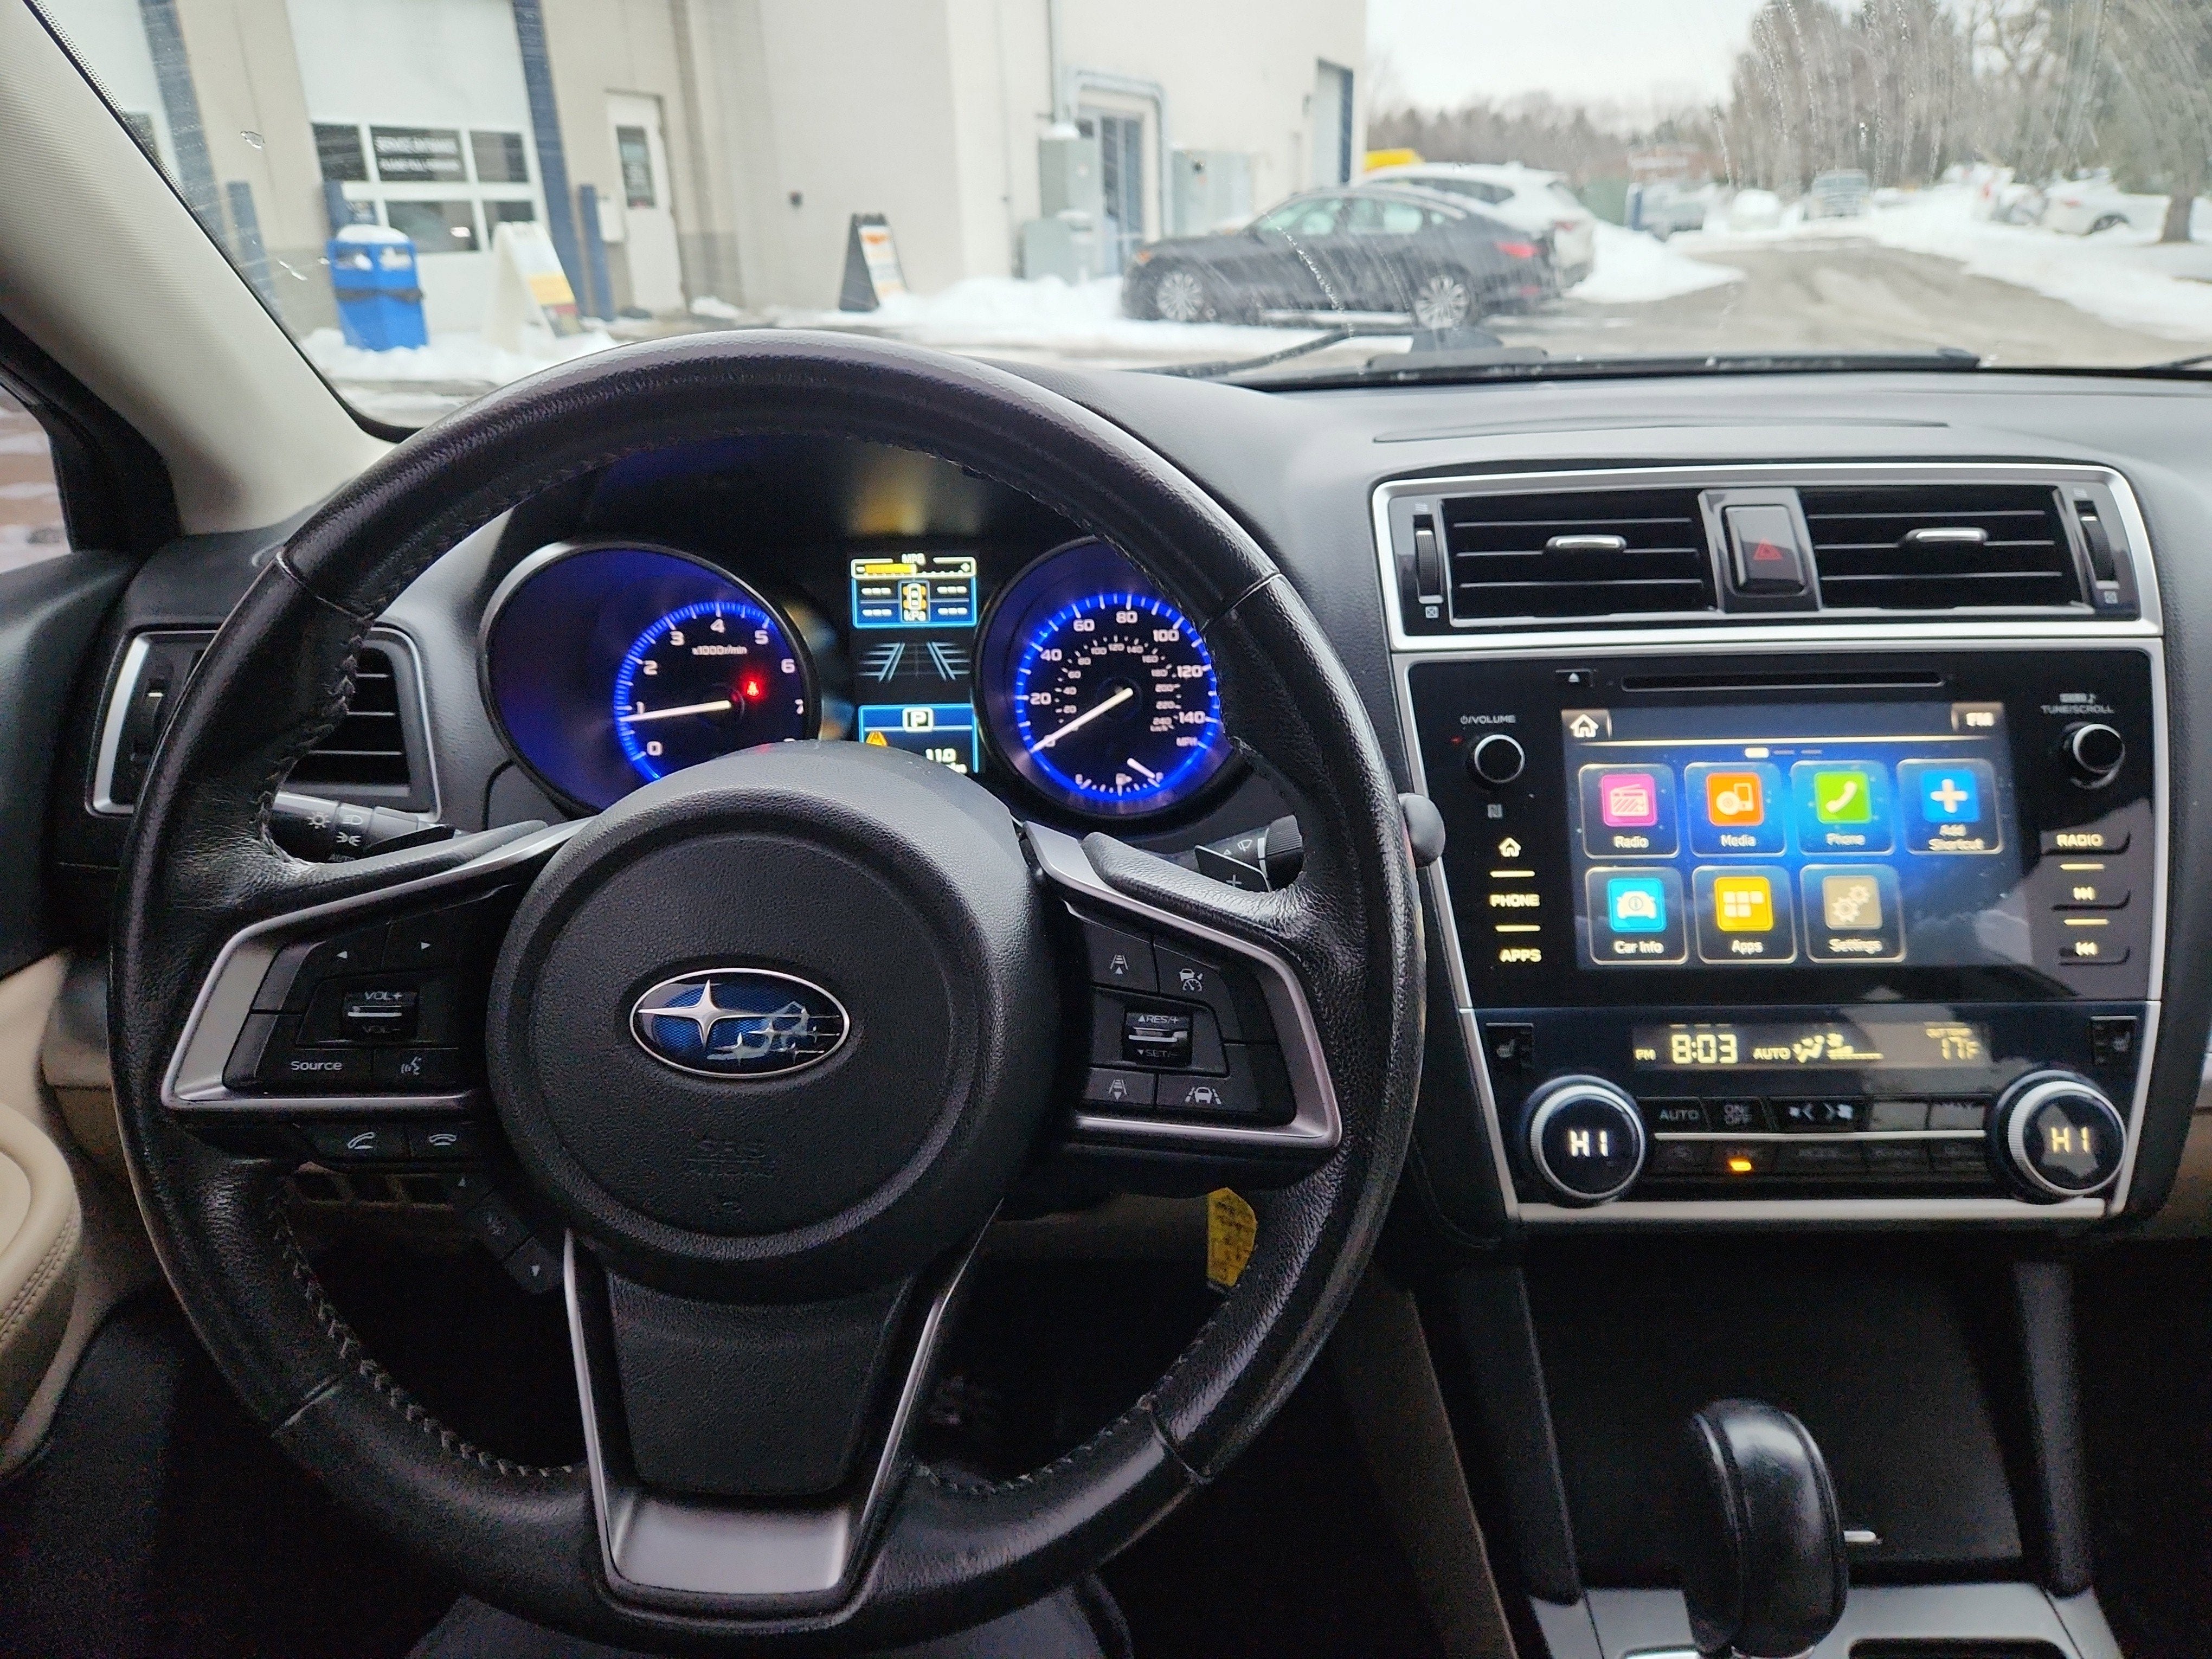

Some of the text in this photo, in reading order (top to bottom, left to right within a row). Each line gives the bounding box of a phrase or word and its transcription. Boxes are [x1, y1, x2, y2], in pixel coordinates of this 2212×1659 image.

[902, 553, 925, 565] MPG
[903, 609, 926, 622] kPa
[1116, 610, 1138, 624] 80
[711, 619, 725, 633] 4
[1073, 619, 1095, 632] 60
[670, 631, 684, 646] 3
[755, 631, 769, 645] 5
[1153, 629, 1180, 642] 100
[1040, 649, 1063, 661] 40
[643, 660, 658, 676] 2
[781, 659, 796, 674] 6
[1177, 665, 1203, 678] 120
[1030, 692, 1052, 705] 20
[910, 711, 927, 727] P
[1179, 711, 1206, 724] 140
[1966, 712, 1994, 726] FM
[647, 741, 663, 756] 0
[1613, 835, 1649, 848] Radio
[1720, 834, 1756, 847] Media
[2056, 834, 2104, 847] RADIO
[1489, 894, 1540, 907] PHONE
[1615, 940, 1664, 954] Car Info
[1732, 940, 1763, 955] Apps
[1829, 938, 1883, 954] Settings
[1499, 949, 1541, 962] APPS
[1636, 1048, 1656, 1060] PM
[1671, 1034, 1738, 1065] 8:03
[1753, 1047, 1790, 1060] AUTO
[291, 1060, 343, 1071] Source
[1660, 1109, 1700, 1121] AUTO
[1570, 1130, 1609, 1157] HI
[2050, 1127, 2090, 1154] HI
